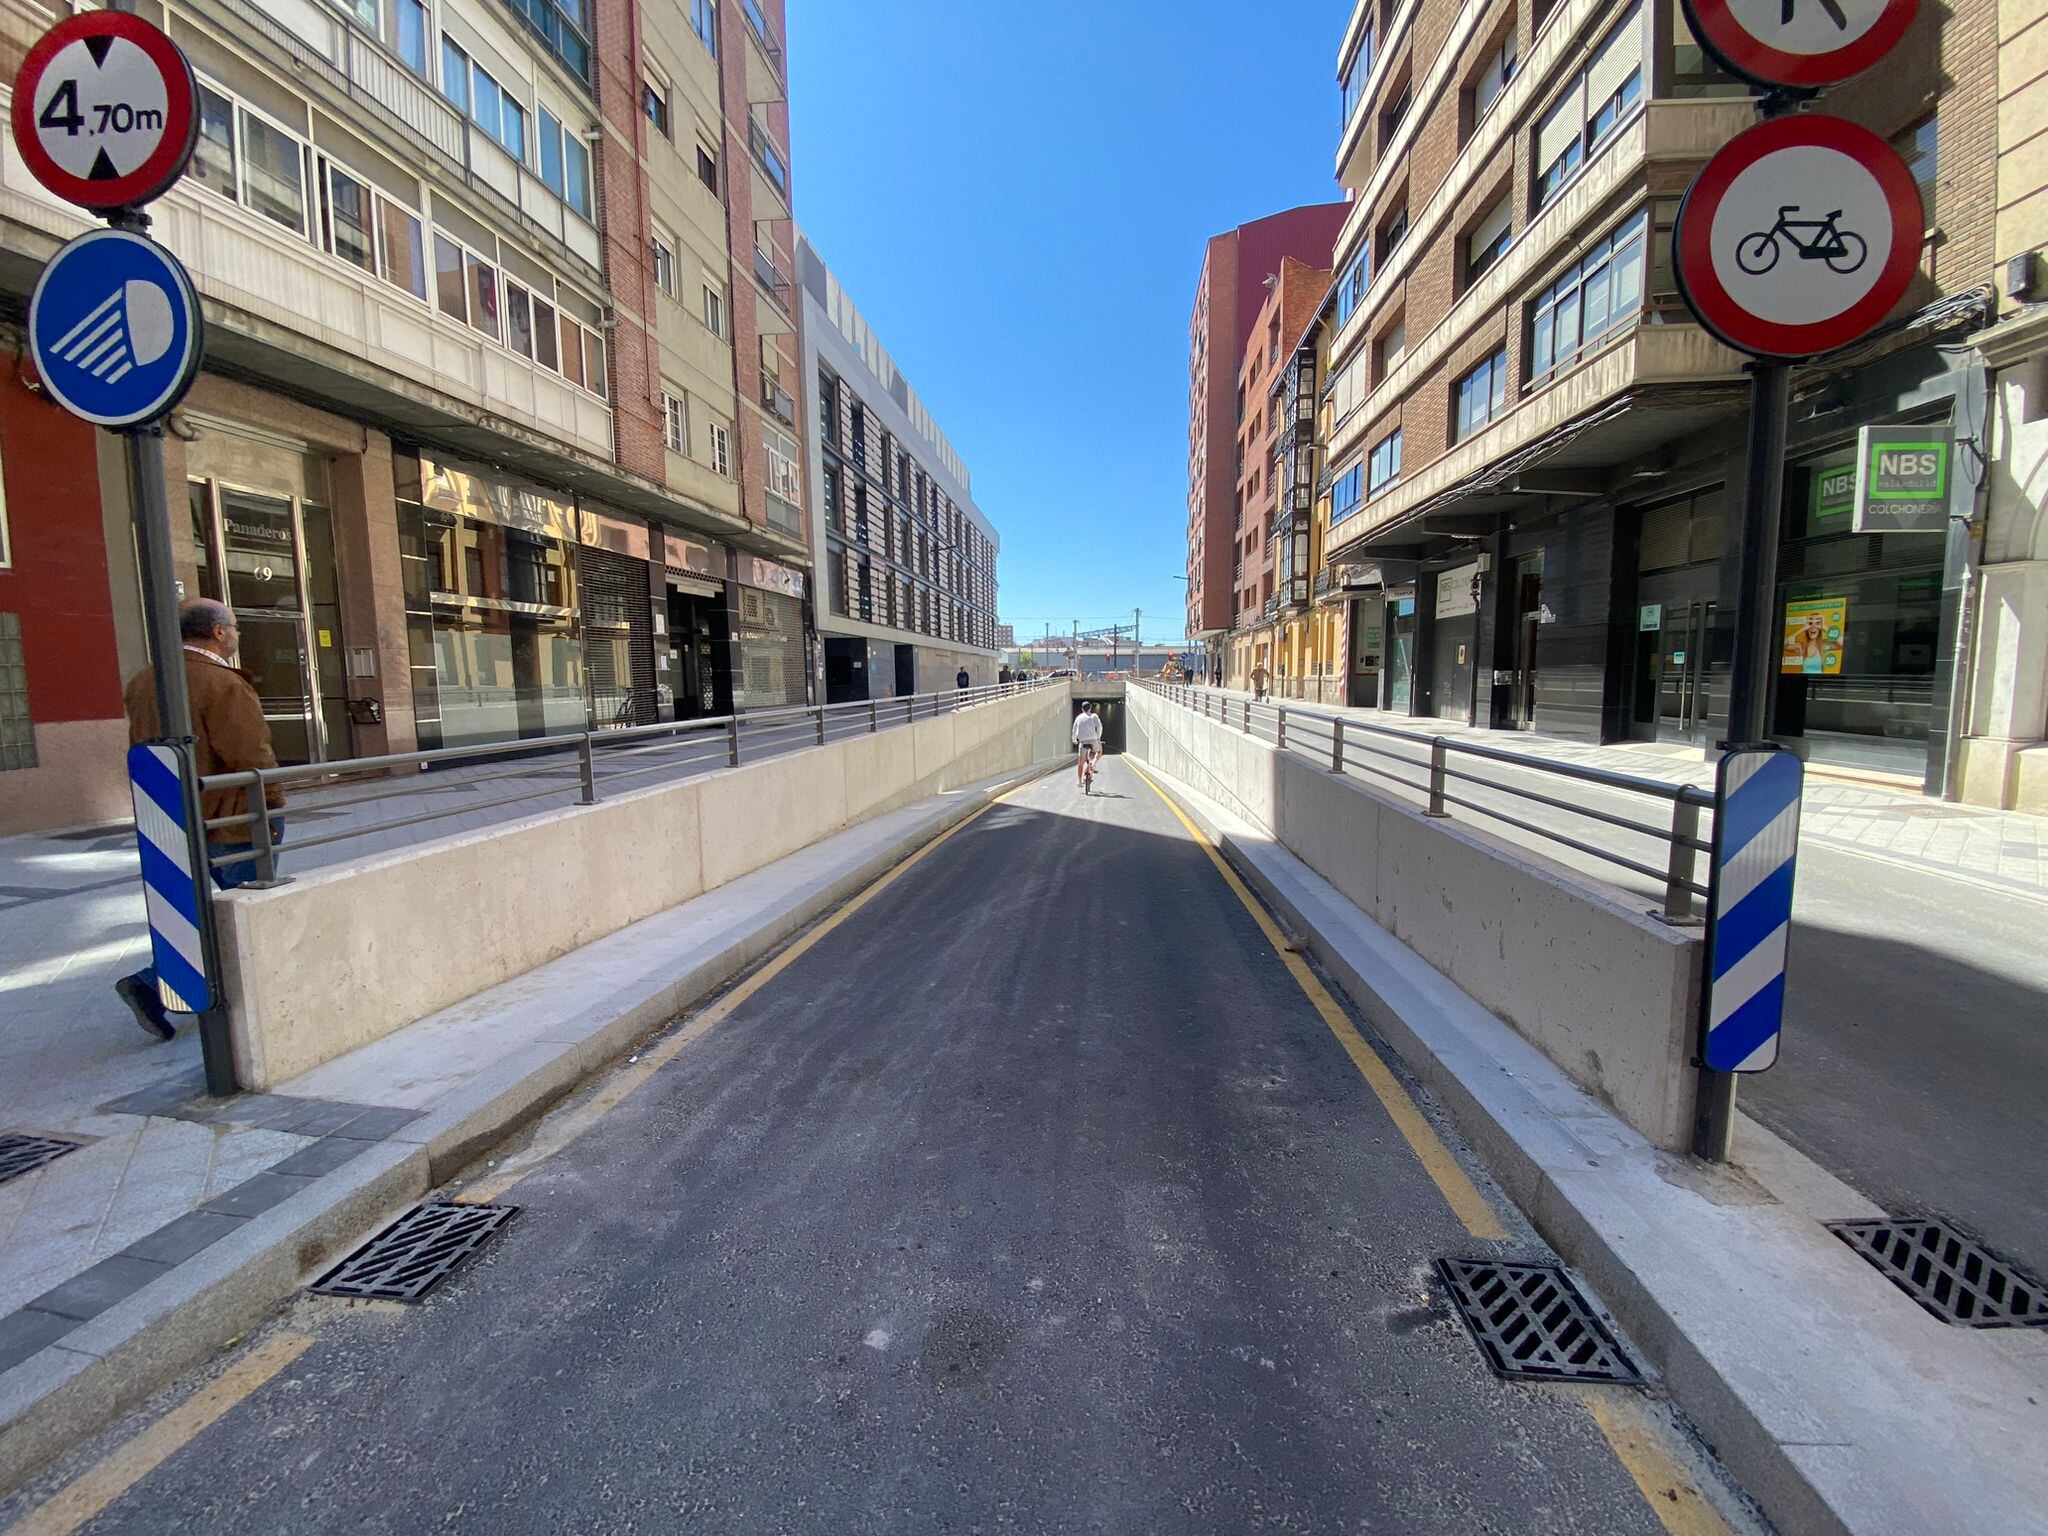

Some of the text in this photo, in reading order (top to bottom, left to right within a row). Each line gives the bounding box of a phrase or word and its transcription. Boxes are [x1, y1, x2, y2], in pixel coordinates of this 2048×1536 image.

[1880, 454, 1937, 476] NBS
[223, 518, 292, 541] Panaderos
[254, 566, 273, 582] 69
